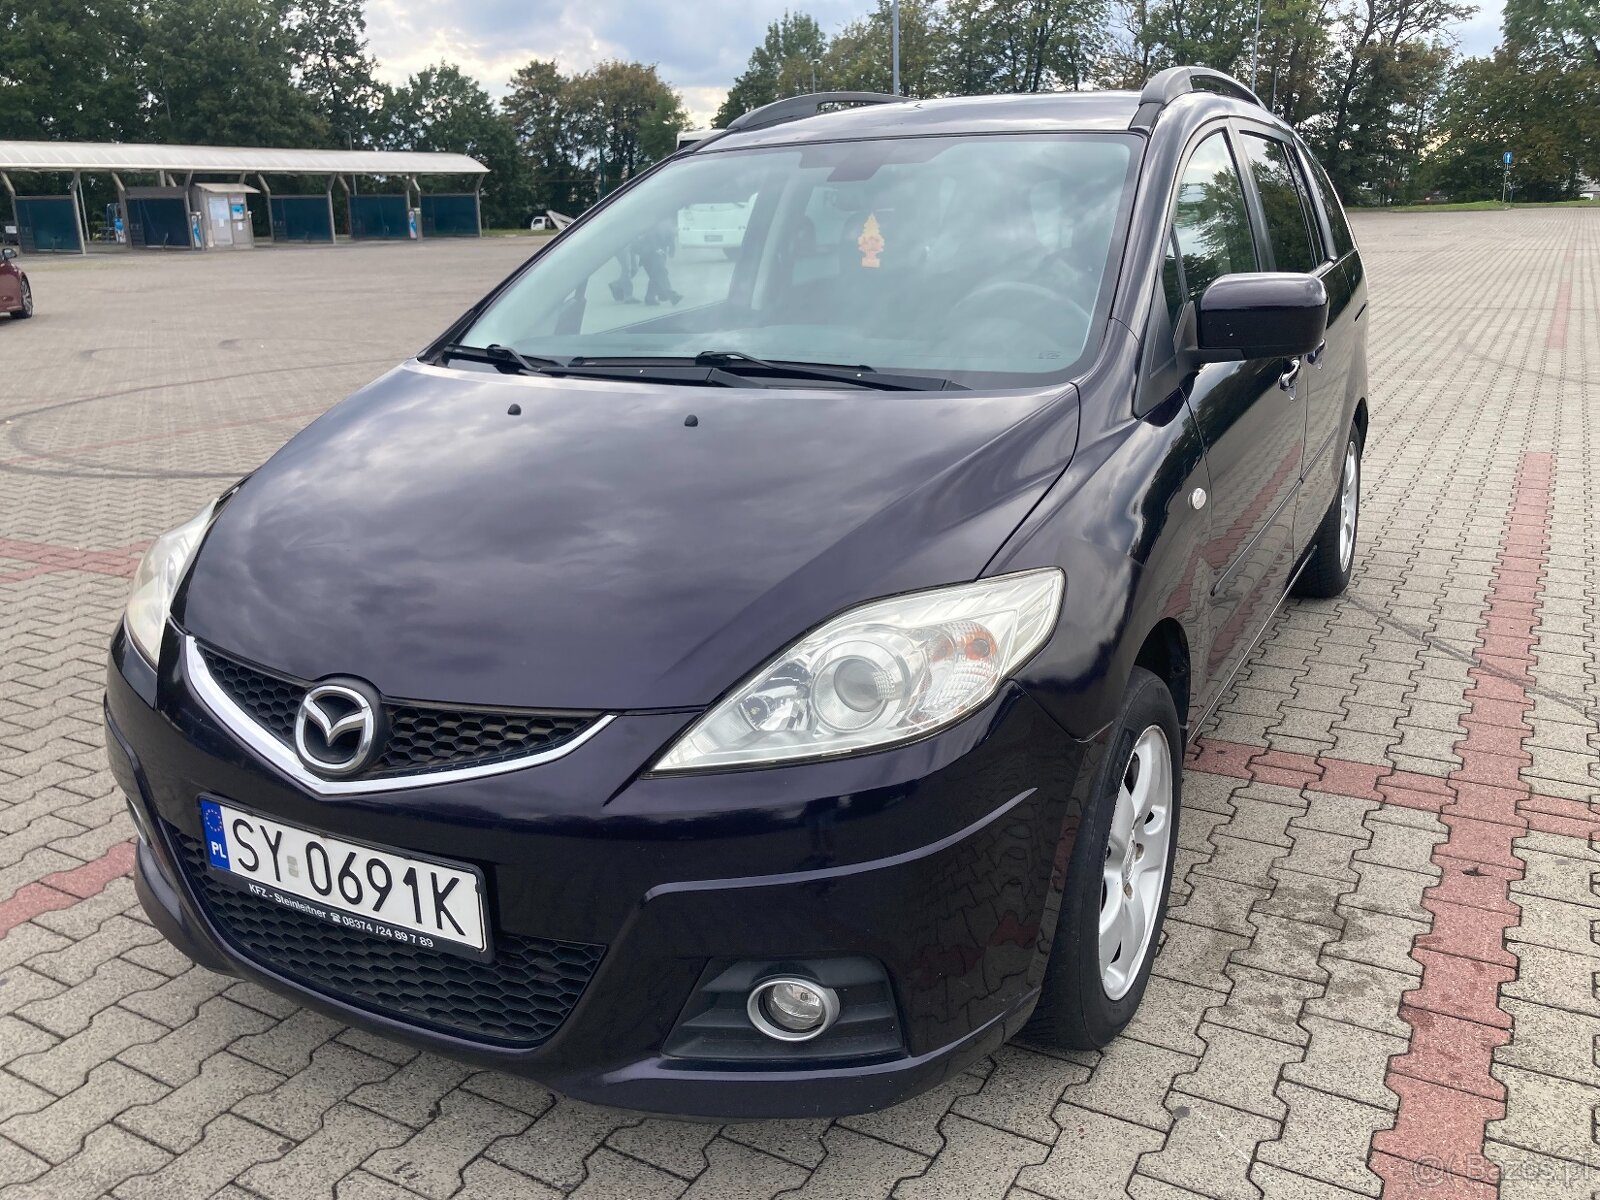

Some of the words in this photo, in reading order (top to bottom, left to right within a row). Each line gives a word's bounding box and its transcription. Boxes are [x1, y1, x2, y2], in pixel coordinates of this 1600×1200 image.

[211, 841, 227, 860] PL
[231, 818, 283, 883] SY
[305, 840, 466, 937] 0691K
[248, 883, 268, 898] KFZ
[274, 892, 327, 919] Steinleitner
[342, 916, 373, 932] 08374
[394, 930, 408, 942] 89
[409, 933, 417, 944] 7
[419, 936, 434, 948] 89
